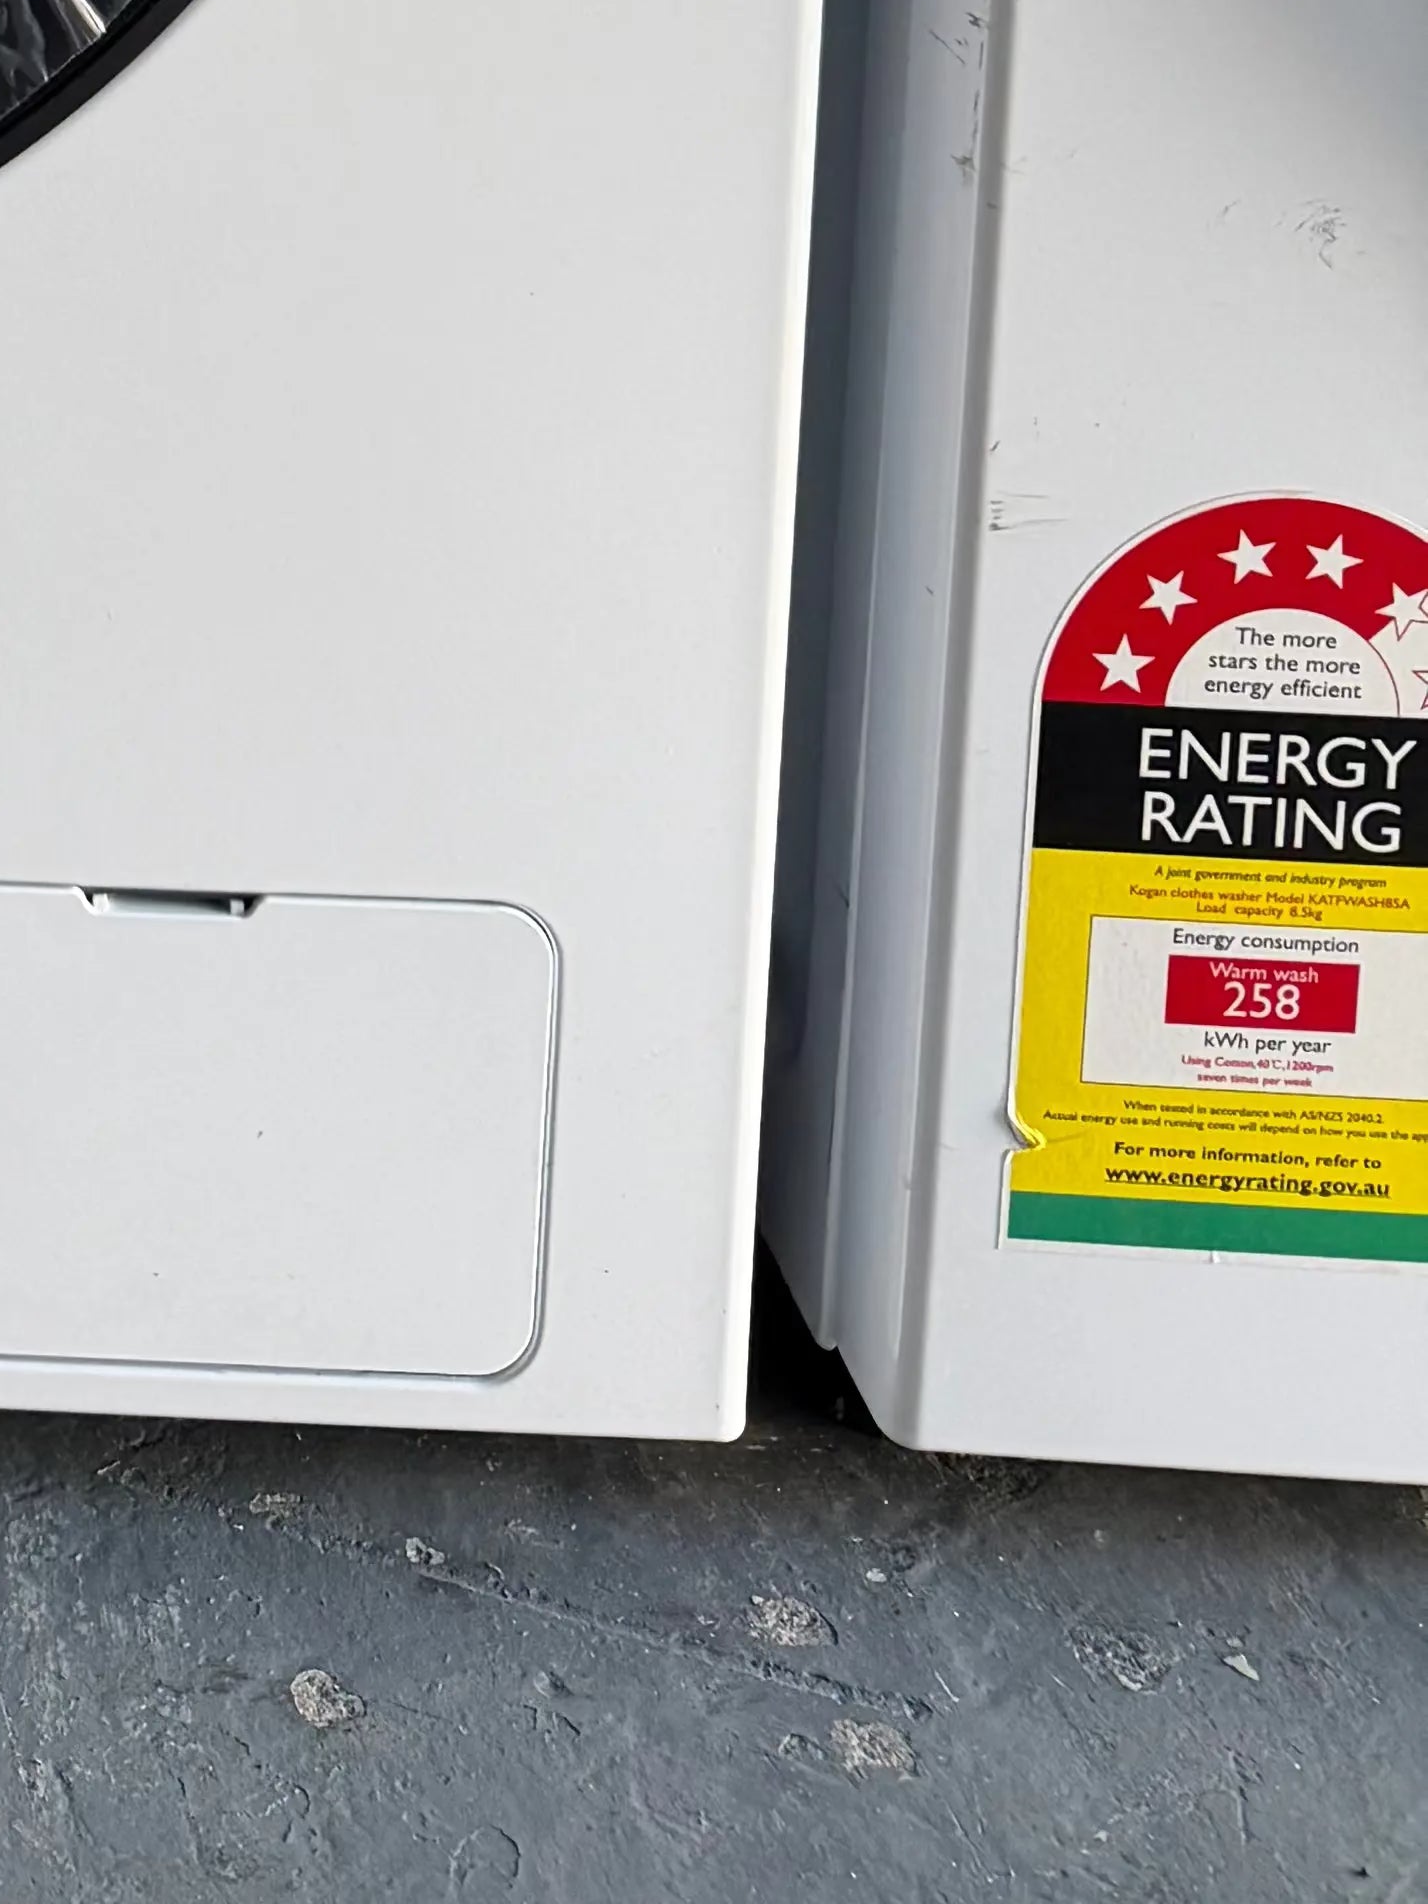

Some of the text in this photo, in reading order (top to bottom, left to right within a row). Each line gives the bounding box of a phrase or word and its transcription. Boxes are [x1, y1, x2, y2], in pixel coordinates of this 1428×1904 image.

[1236, 627, 1337, 649] The more
[1208, 654, 1361, 674] stars the more
[1204, 679, 1362, 700] energy efficient
[1139, 727, 1417, 790] ENERGY
[1141, 791, 1402, 854] RATING
[1155, 865, 1163, 876] A
[1194, 870, 1261, 881] government
[1265, 873, 1287, 883] and
[1290, 873, 1336, 888] industry
[1338, 876, 1386, 890] program
[1130, 884, 1167, 899] Kogan
[1170, 887, 1214, 900] clothes
[1218, 890, 1263, 902] washer
[1266, 892, 1304, 904] Model
[1197, 901, 1226, 914] Load
[1234, 906, 1283, 919] capacity
[1173, 928, 1359, 955] Energy consumption
[1209, 961, 1319, 983] Warm wash
[1223, 981, 1301, 1020] 258
[1204, 1031, 1331, 1056] kWh per year
[1182, 1055, 1211, 1068] Using
[1263, 1078, 1281, 1087] per
[1123, 1100, 1157, 1111] When
[1197, 1105, 1207, 1114] in
[1273, 1110, 1296, 1119] with
[1081, 1114, 1116, 1125] energy
[1142, 1117, 1160, 1126] and
[1164, 1119, 1204, 1130] running
[1239, 1122, 1257, 1131] will
[1260, 1124, 1300, 1134] depend
[1320, 1126, 1342, 1136] how
[1346, 1130, 1366, 1138] you
[1369, 1131, 1387, 1139] use
[1391, 1130, 1408, 1140] the
[1114, 1142, 1382, 1170] For more information, refer to
[1105, 1168, 1390, 1197] www.energyrating.gov.au
